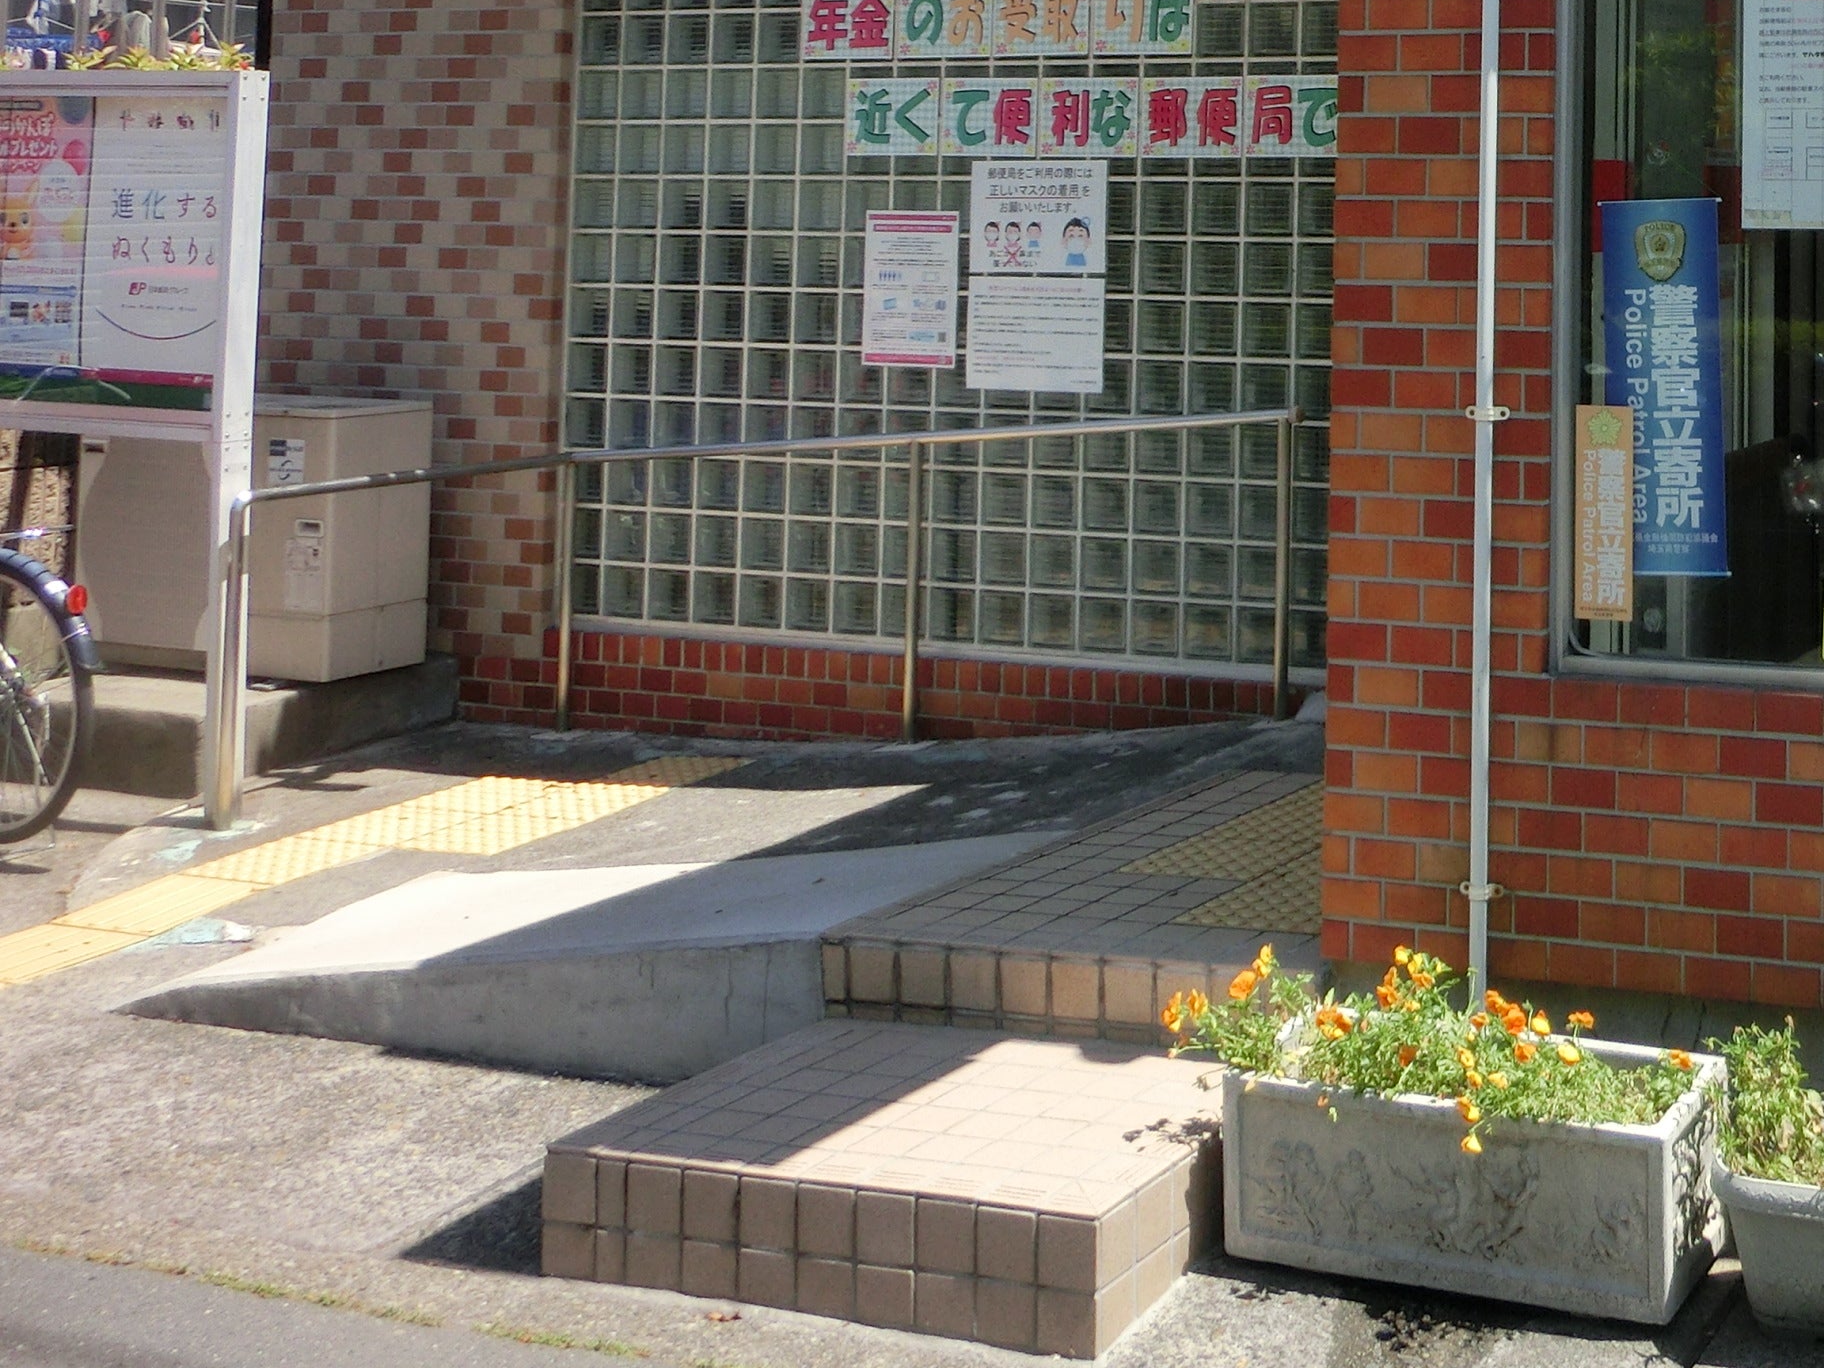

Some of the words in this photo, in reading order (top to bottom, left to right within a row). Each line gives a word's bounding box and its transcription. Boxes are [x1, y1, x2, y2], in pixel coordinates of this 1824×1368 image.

[855, 85, 1339, 150] 近くて便利な郵便局で
[111, 187, 218, 221] 進化する
[988, 183, 1091, 198] 正しいマスクの着用を
[998, 200, 1078, 215] お願いいたします。
[1644, 223, 1676, 233] POLICE
[1624, 288, 1648, 370] Police
[1626, 378, 1652, 455] Patrol
[1648, 283, 1705, 529] 警察官立寄所
[1583, 449, 1598, 502] Police
[1634, 466, 1654, 524] Area
[1582, 506, 1598, 558] Patrol
[1597, 447, 1626, 606] 警察官立寄所
[1582, 563, 1594, 602] Area
